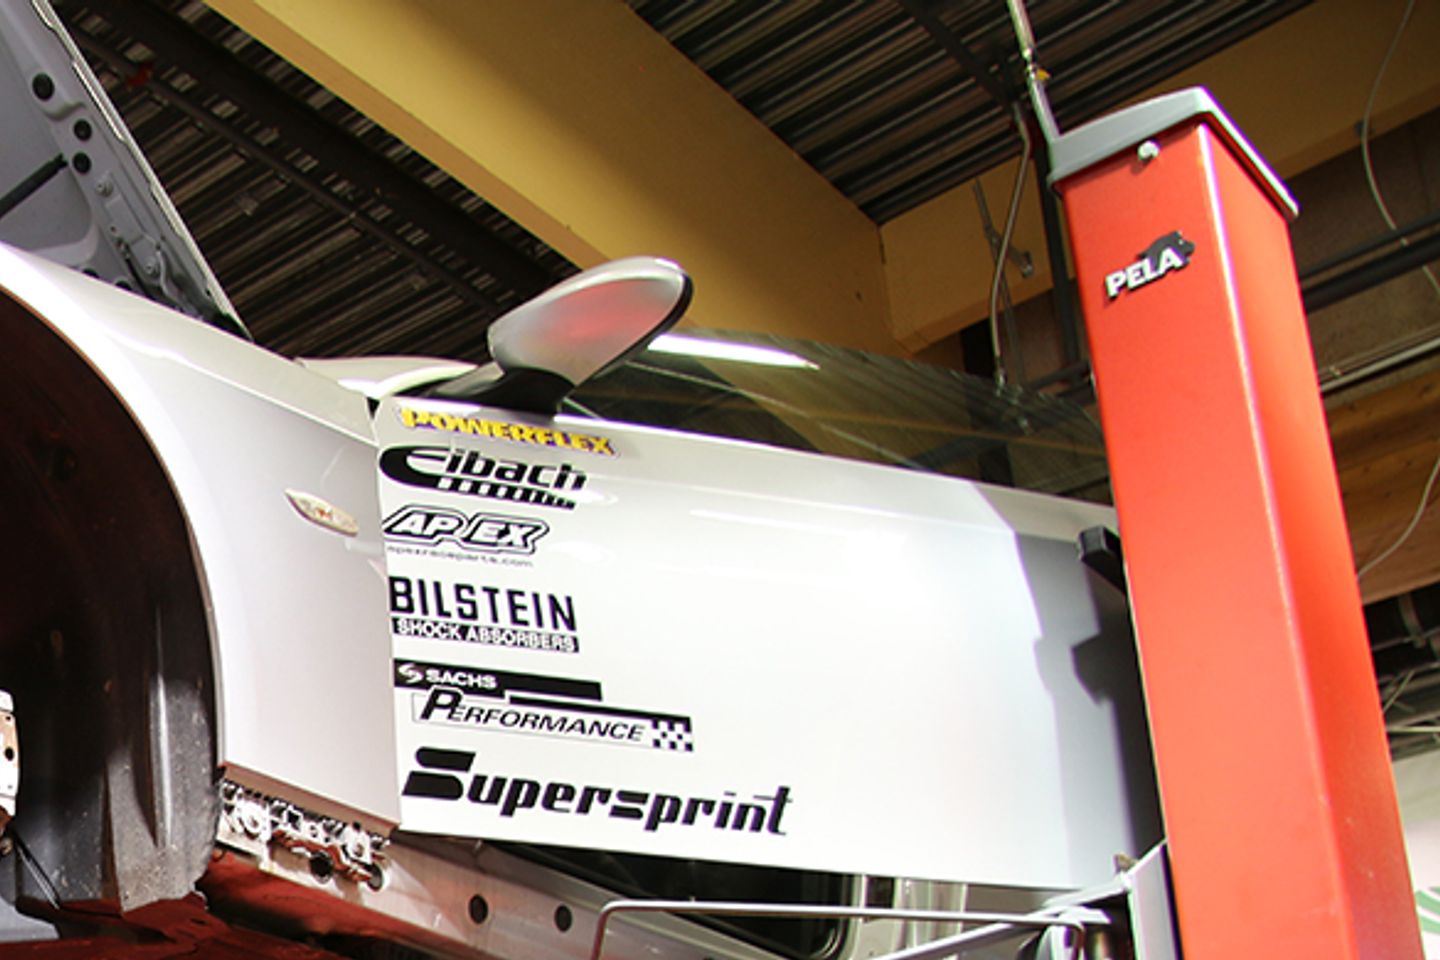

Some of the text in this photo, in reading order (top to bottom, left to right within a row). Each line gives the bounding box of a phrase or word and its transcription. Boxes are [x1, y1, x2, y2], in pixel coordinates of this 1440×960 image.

[1105, 248, 1184, 299] PELA
[399, 406, 617, 457] POWERFLEX
[379, 445, 587, 502] Eibach
[386, 508, 543, 551] APEX
[389, 575, 577, 631] BILSTEIN
[396, 618, 577, 653] SHOCK ABSORBERS
[425, 667, 497, 690] SACHS
[402, 746, 793, 836] Supersprint
